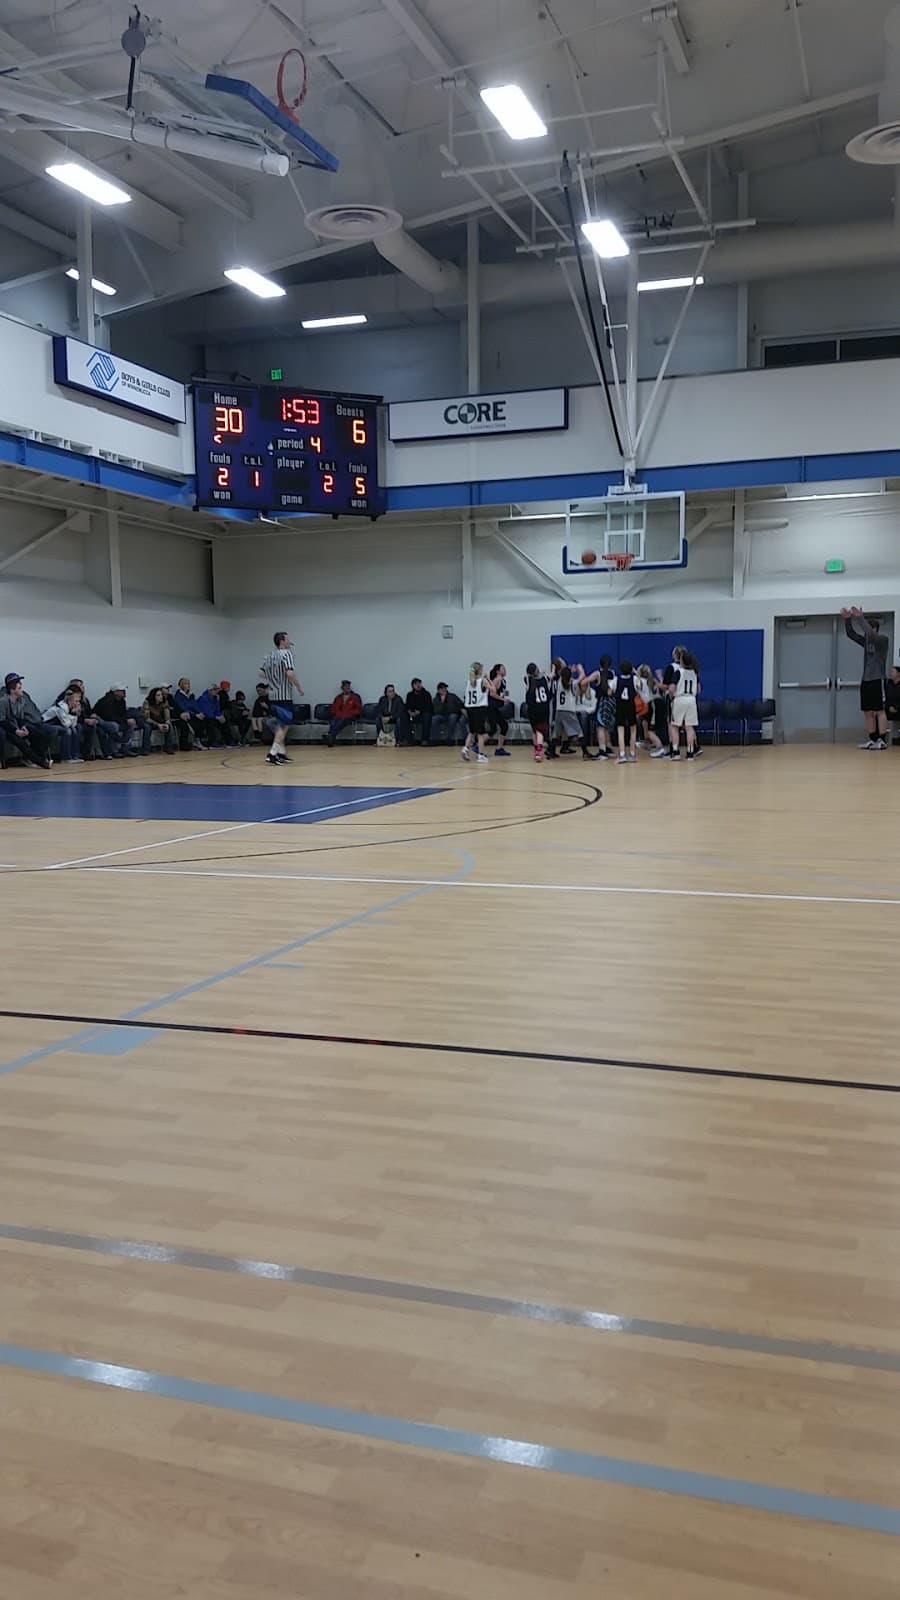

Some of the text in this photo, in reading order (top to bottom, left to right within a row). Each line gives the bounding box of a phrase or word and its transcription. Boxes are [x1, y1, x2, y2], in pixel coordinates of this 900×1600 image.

[121, 372, 136, 384] BOYS
[141, 380, 157, 393] GIRLS
[157, 386, 171, 398] CLUB
[214, 392, 238, 405] Home
[282, 398, 320, 424] 1:53
[336, 404, 364, 417] Guests
[444, 400, 506, 424] CORE
[215, 406, 242, 433] 30
[352, 419, 366, 444] 6
[277, 438, 304, 450] period
[310, 436, 321, 453] 4
[210, 451, 231, 464] fouls
[277, 456, 304, 469] player
[348, 462, 368, 474] fouls
[218, 467, 229, 486] 2
[254, 470, 260, 487] 1
[323, 475, 333, 493] 2
[355, 477, 366, 495] 5
[213, 490, 231, 500] won
[281, 495, 303, 505] game
[351, 498, 367, 508] won
[621, 687, 629, 700] 4
[684, 679, 693, 694] 11
[468, 690, 478, 705] 15
[560, 691, 566, 705] 6
